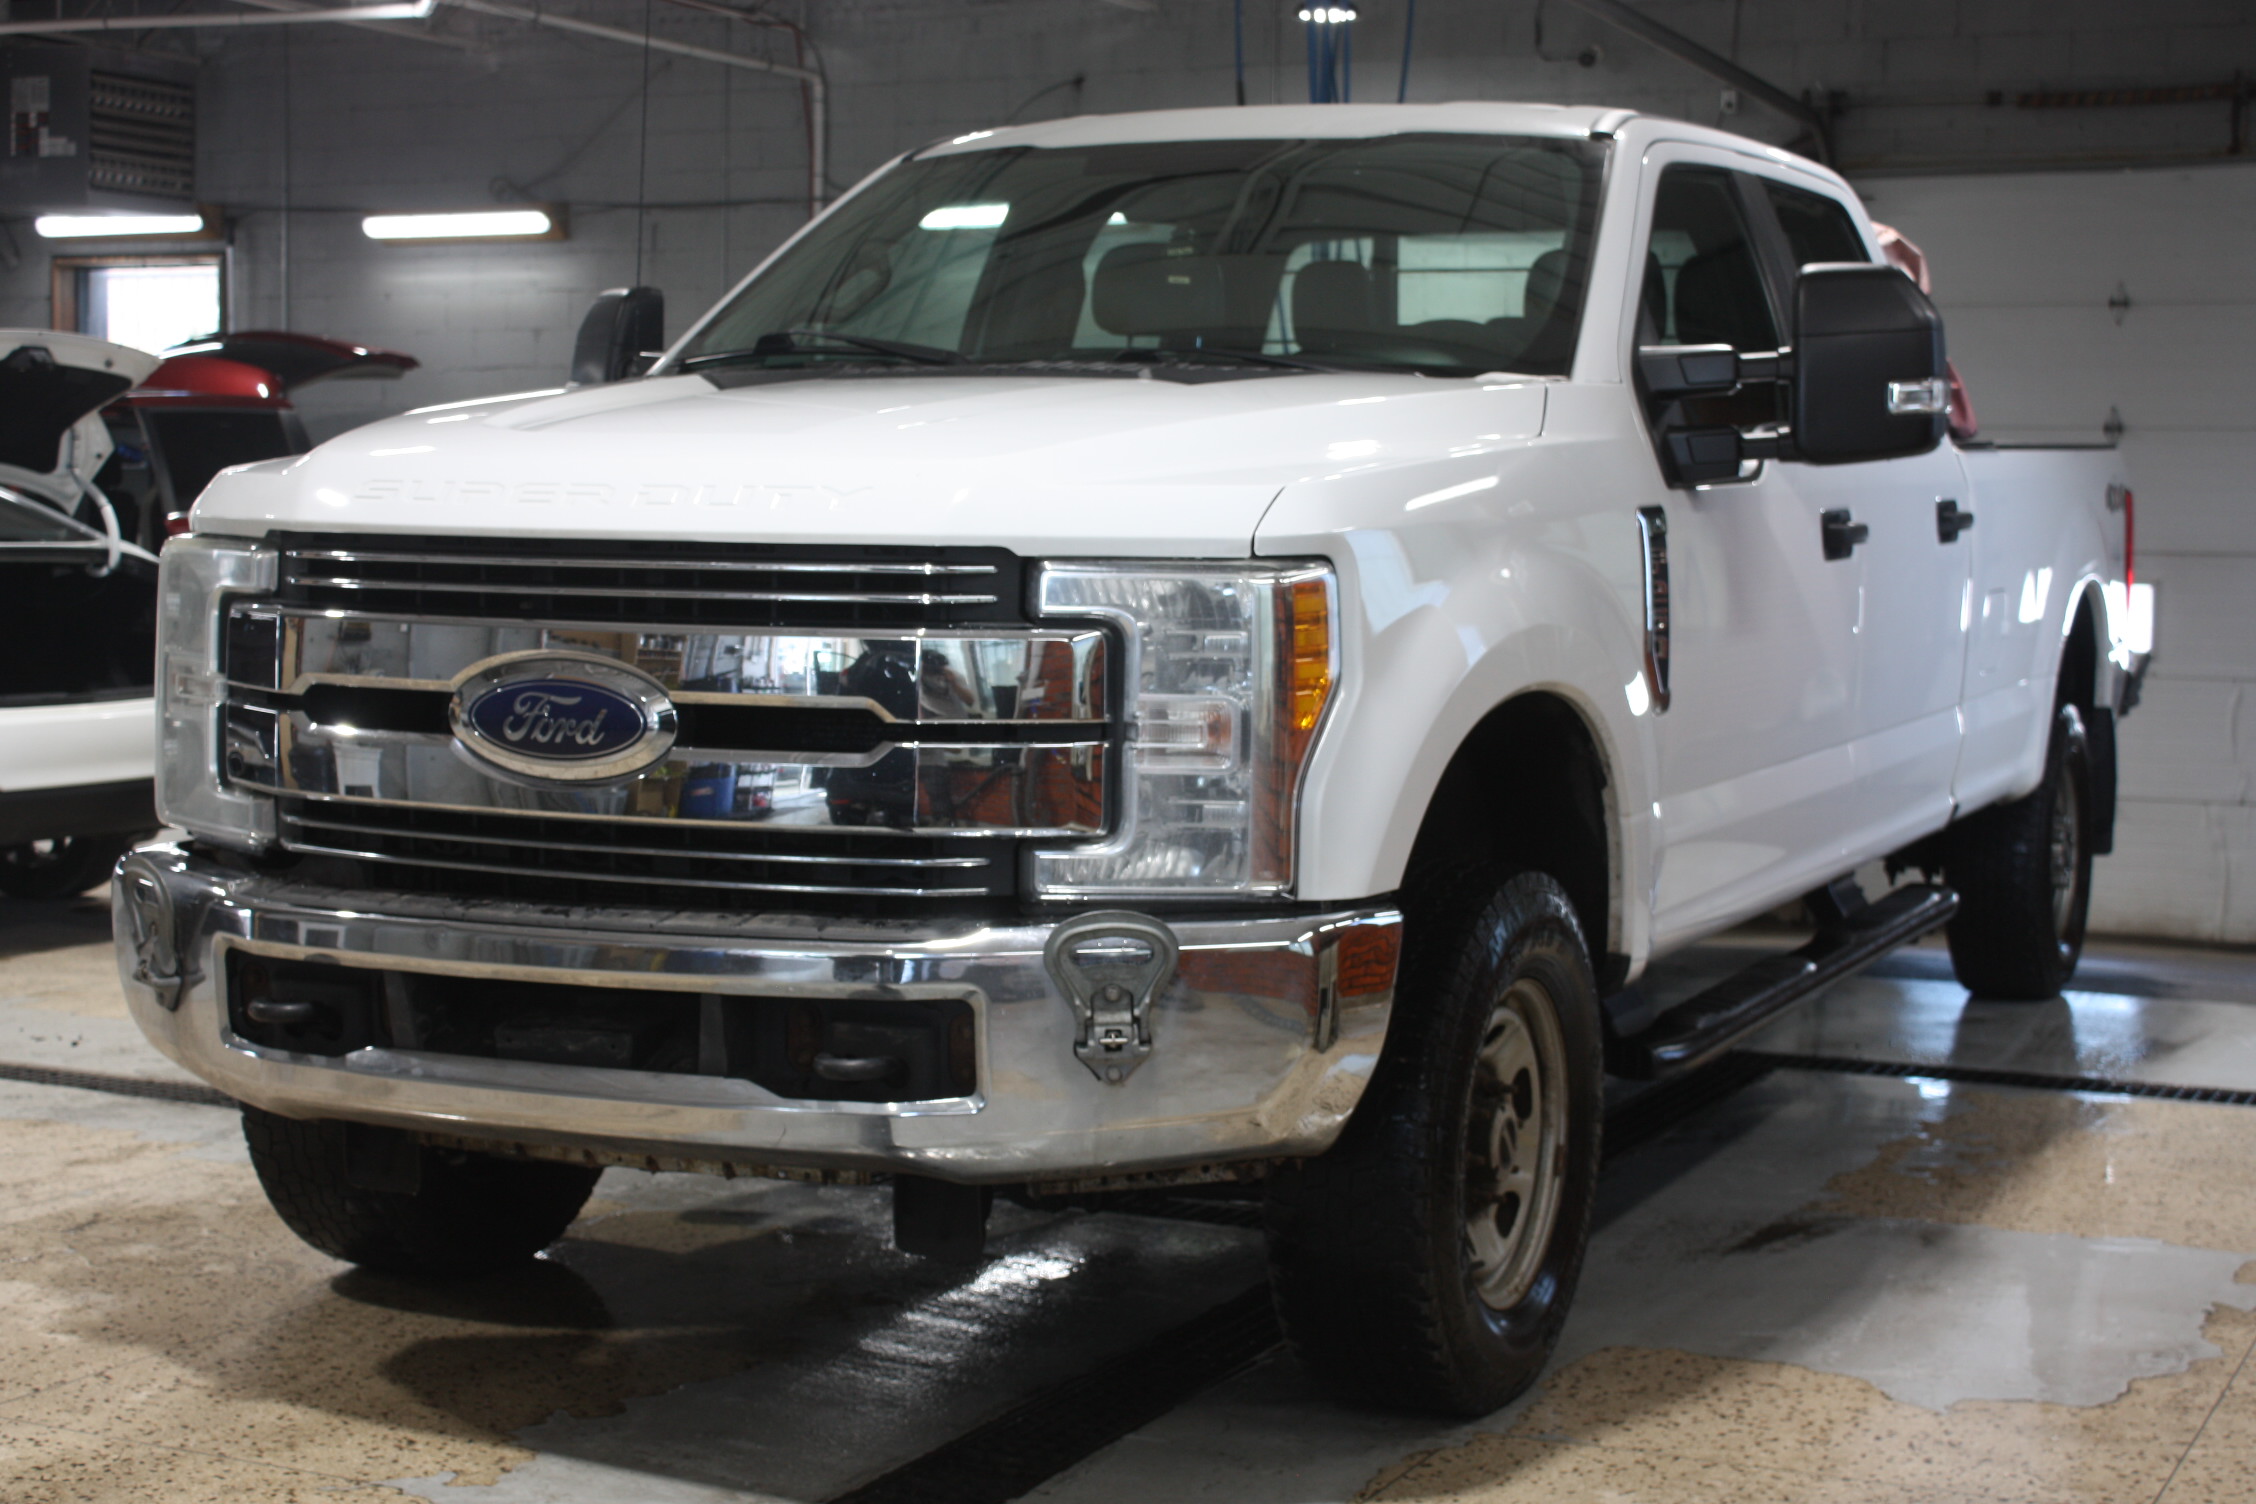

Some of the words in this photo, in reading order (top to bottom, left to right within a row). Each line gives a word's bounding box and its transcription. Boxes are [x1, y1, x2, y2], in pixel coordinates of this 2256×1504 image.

[353, 478, 617, 505] SUPER
[631, 482, 874, 511] DUTY
[502, 691, 607, 746] Ford
